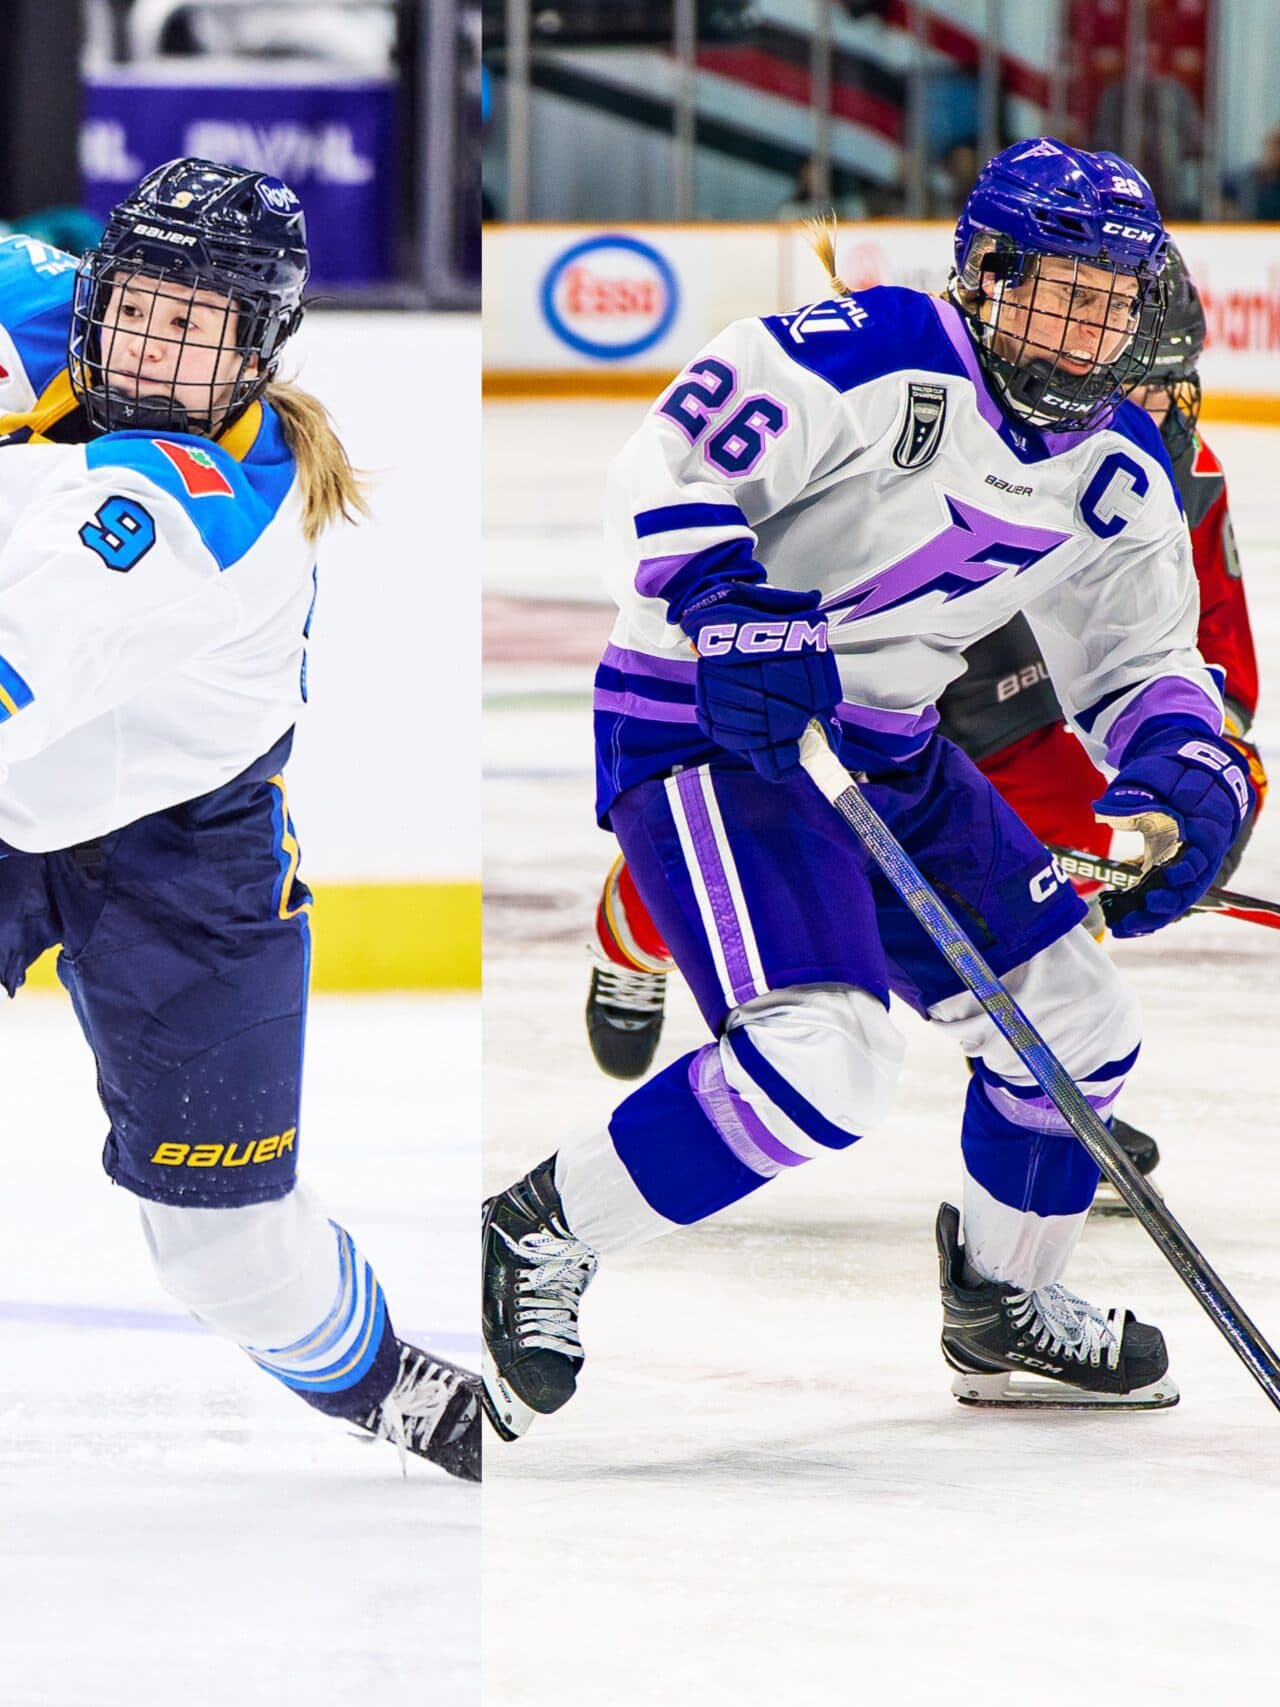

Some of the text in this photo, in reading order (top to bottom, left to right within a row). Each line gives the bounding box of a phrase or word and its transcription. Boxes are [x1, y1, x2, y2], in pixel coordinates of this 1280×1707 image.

[1111, 176, 1143, 198] 26
[1102, 221, 1156, 243] CCM
[656, 355, 789, 478] 26
[1079, 452, 1150, 539] C
[78, 494, 156, 573] 9
[697, 620, 828, 657] CCM
[1005, 1351, 1063, 1374] CCM
